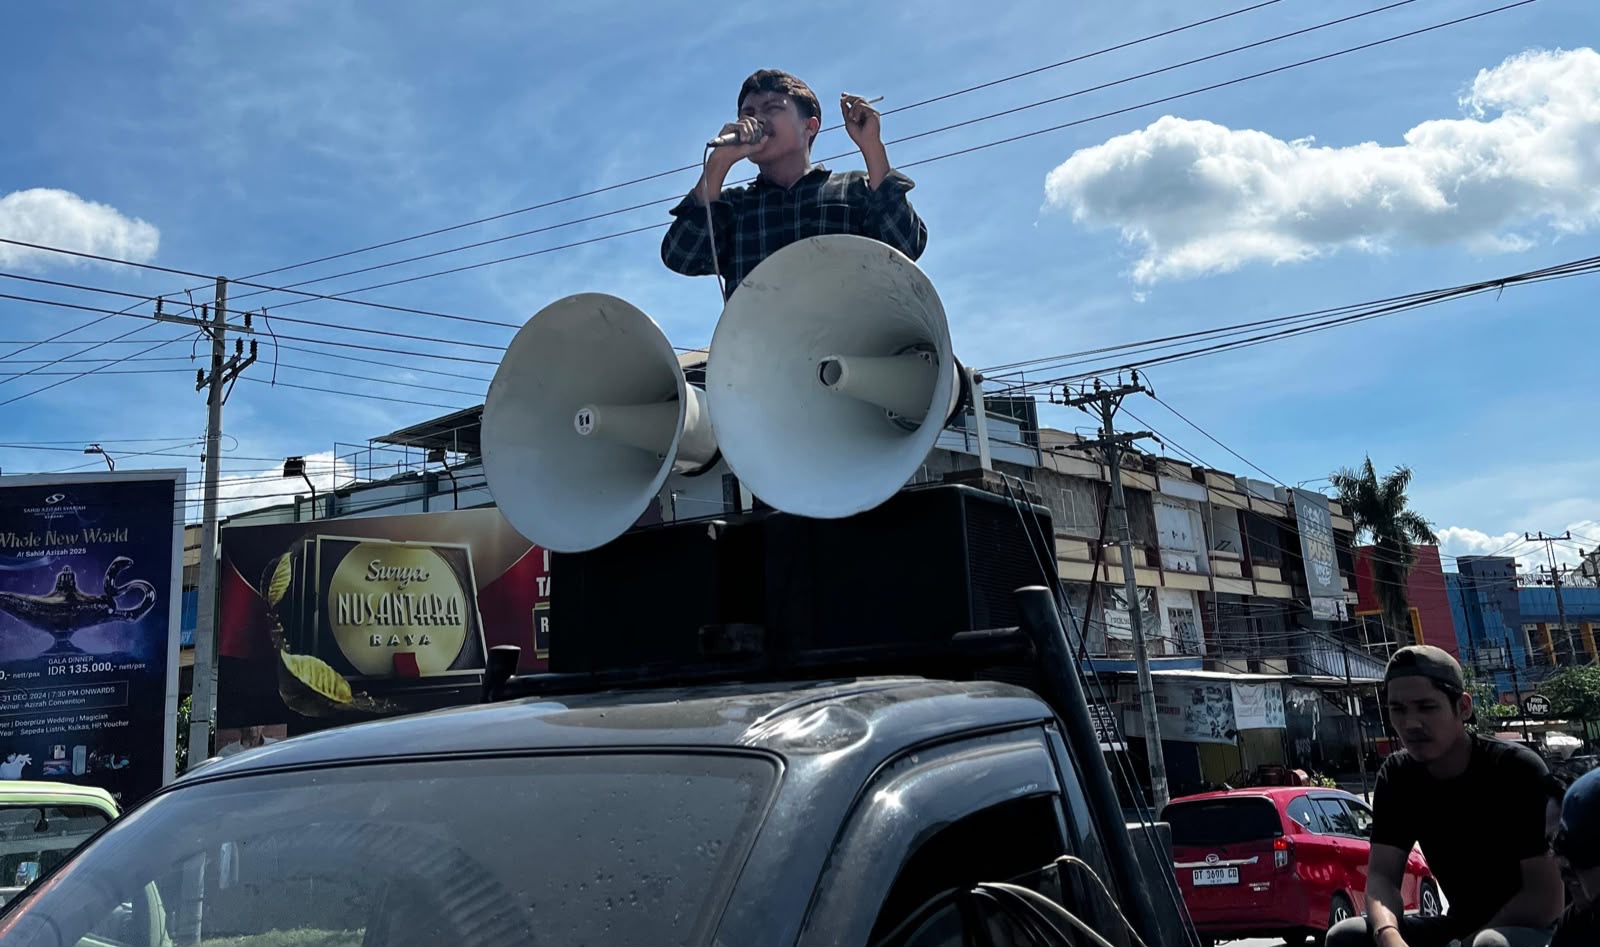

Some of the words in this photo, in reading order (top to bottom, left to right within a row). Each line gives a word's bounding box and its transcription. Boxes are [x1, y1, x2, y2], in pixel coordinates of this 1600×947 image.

[45, 530, 78, 546] New
[82, 528, 128, 544] World
[25, 550, 45, 558] Sahid
[45, 548, 68, 557] Azizah
[365, 560, 430, 590] Surya
[337, 592, 462, 626] NUSANTARA
[370, 634, 432, 648] RAYA
[68, 656, 94, 664] DINNER
[48, 665, 66, 676] IDR
[69, 662, 117, 674] 135.000,-
[80, 686, 115, 695] ONWARDS
[48, 698, 86, 707] Convention
[14, 719, 45, 728] Doorprize
[47, 717, 75, 725] Wedding
[79, 714, 108, 722] Magician
[20, 727, 44, 736] Sepeda
